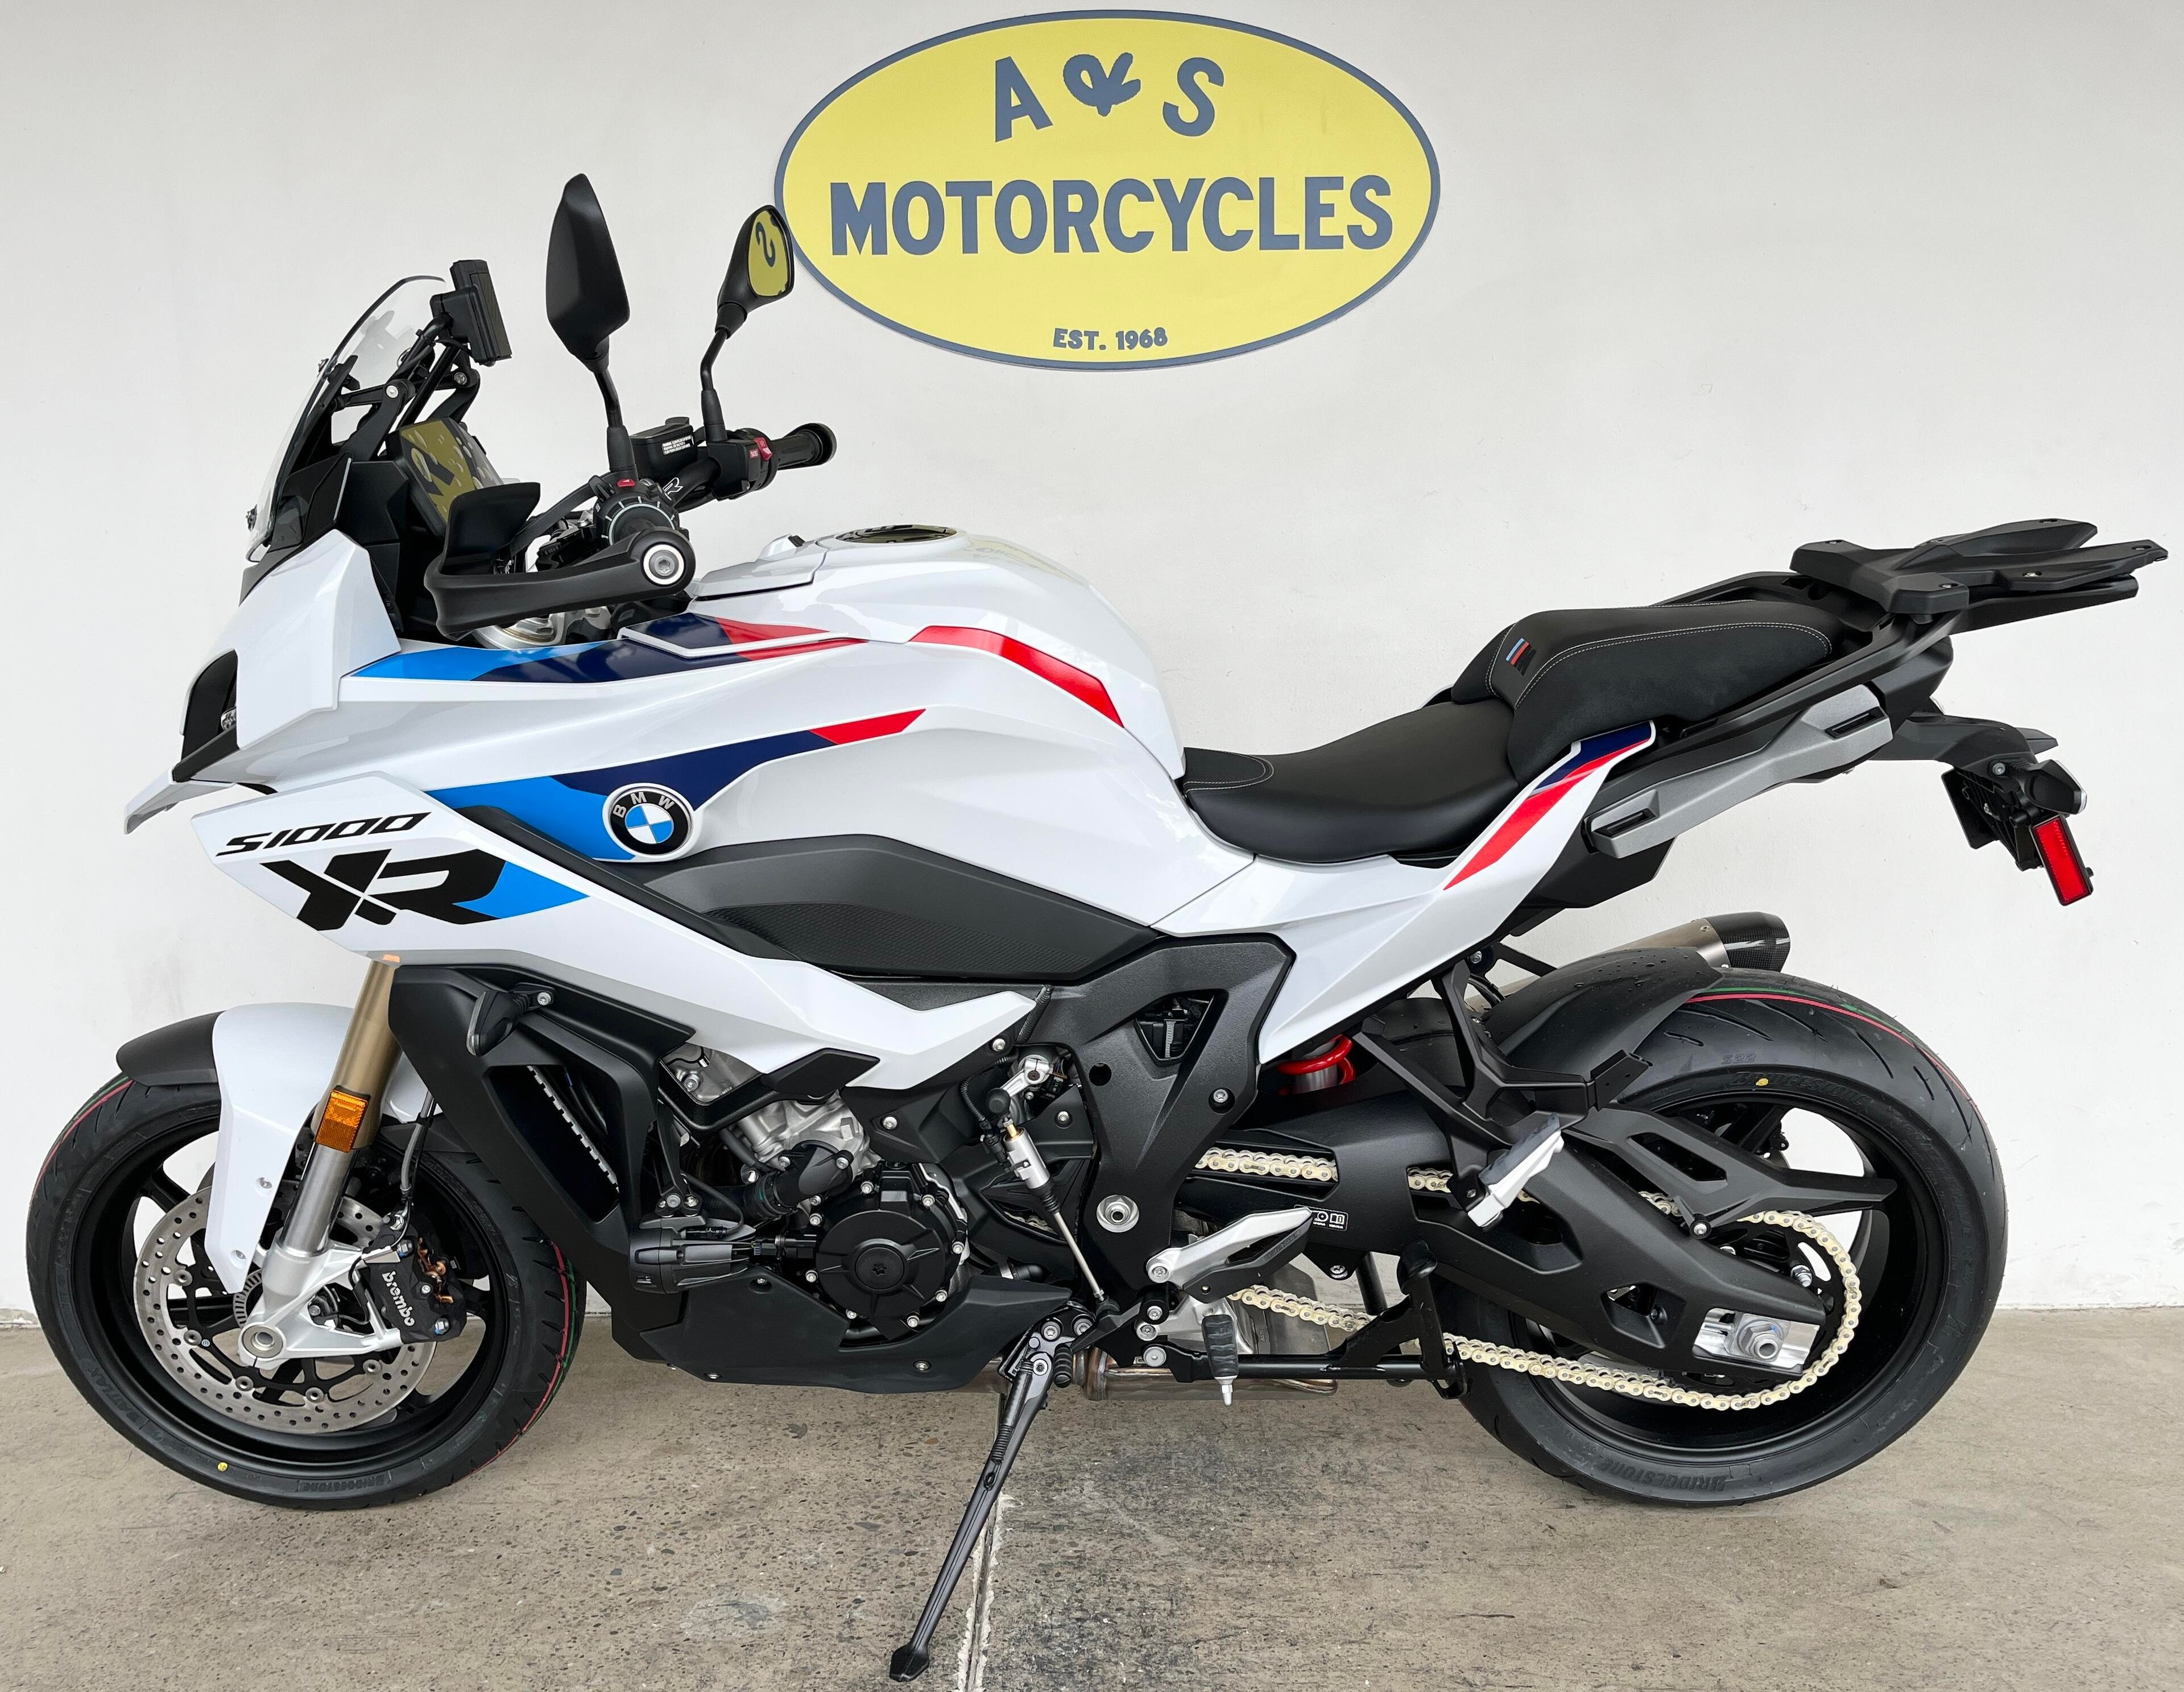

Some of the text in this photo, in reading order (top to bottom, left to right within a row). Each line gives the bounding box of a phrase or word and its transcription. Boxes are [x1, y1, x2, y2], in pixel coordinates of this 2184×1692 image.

[995, 57, 1053, 142] A
[1163, 57, 1224, 137] S
[830, 175, 1393, 256] MOTORCYCLES
[1053, 327, 1168, 350] EST. 1968
[613, 792, 675, 818] BMW
[216, 812, 432, 857] S1000
[260, 849, 507, 931] XR
[1722, 1053, 1756, 1065] S22
[382, 1271, 415, 1326] brembo
